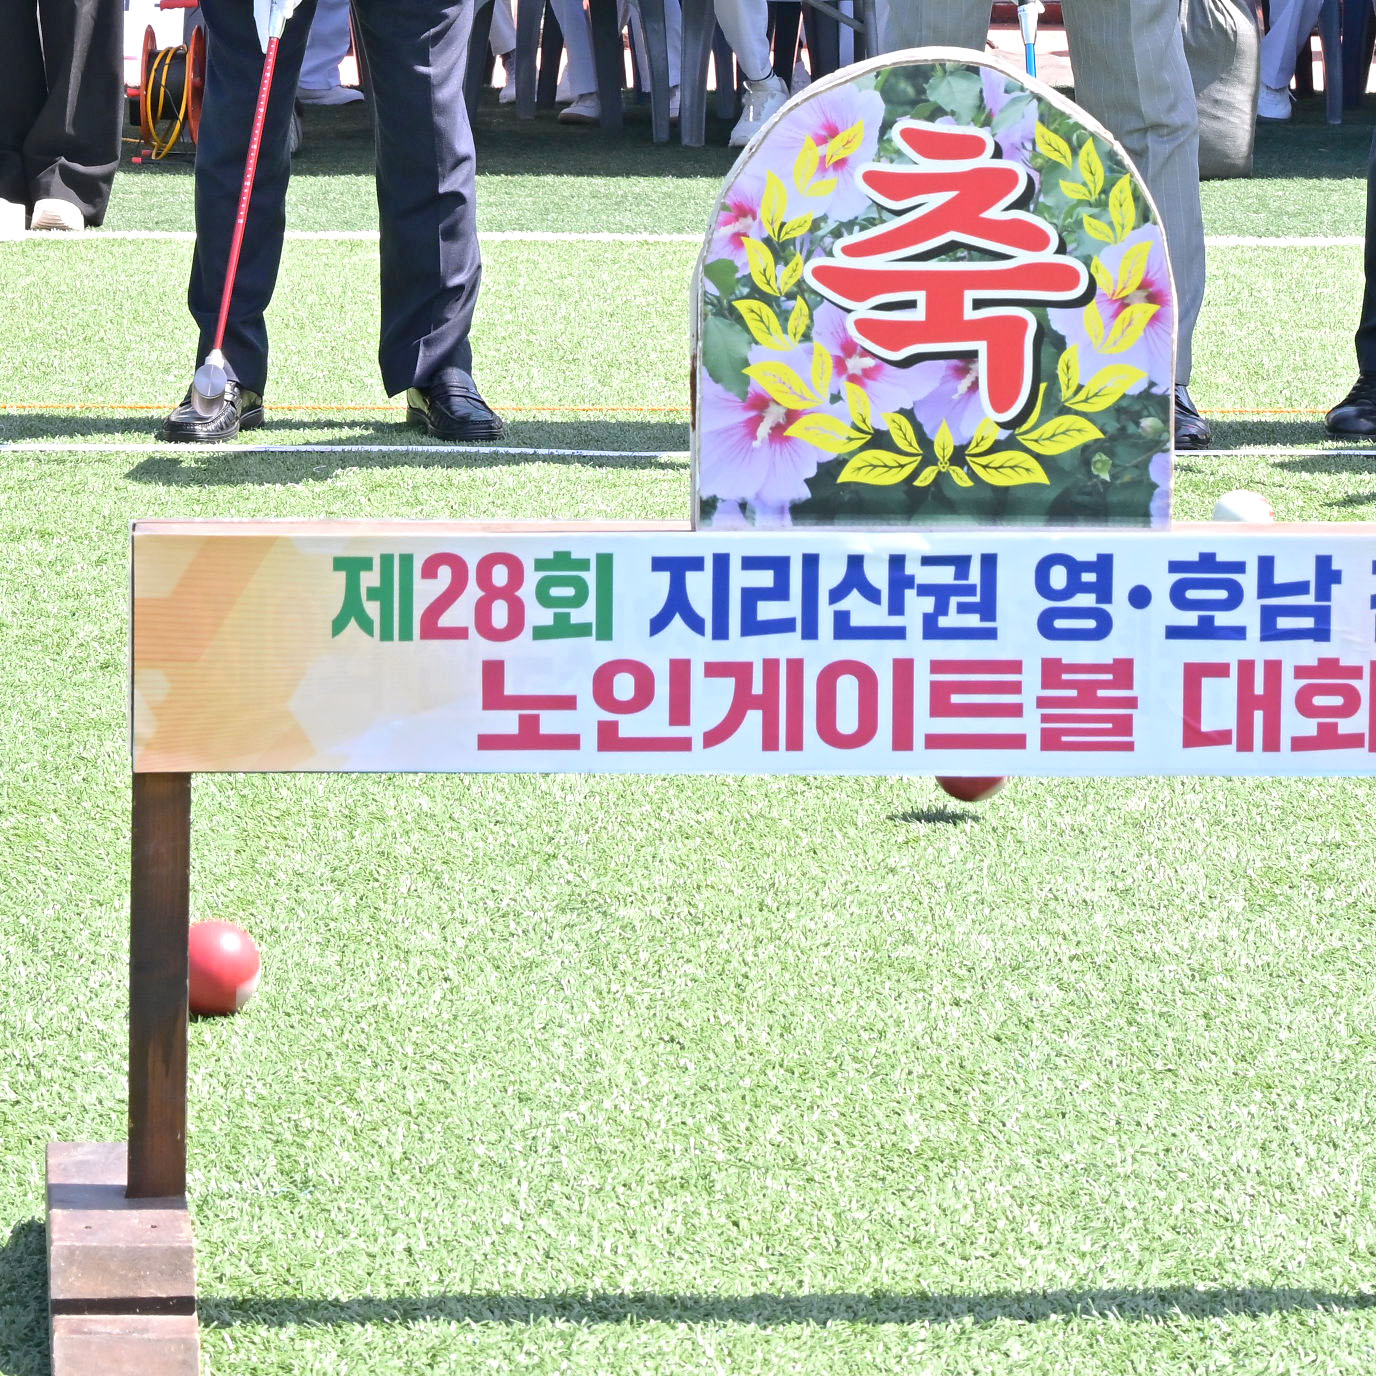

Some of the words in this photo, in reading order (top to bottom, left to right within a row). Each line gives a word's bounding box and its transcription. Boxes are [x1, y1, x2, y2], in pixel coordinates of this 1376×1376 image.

[807, 122, 1086, 421] 축
[331, 550, 614, 642] 제28회
[649, 552, 998, 642] 지리산권
[1034, 551, 1343, 643] 영·호남
[476, 657, 1139, 753] 노인게이트볼
